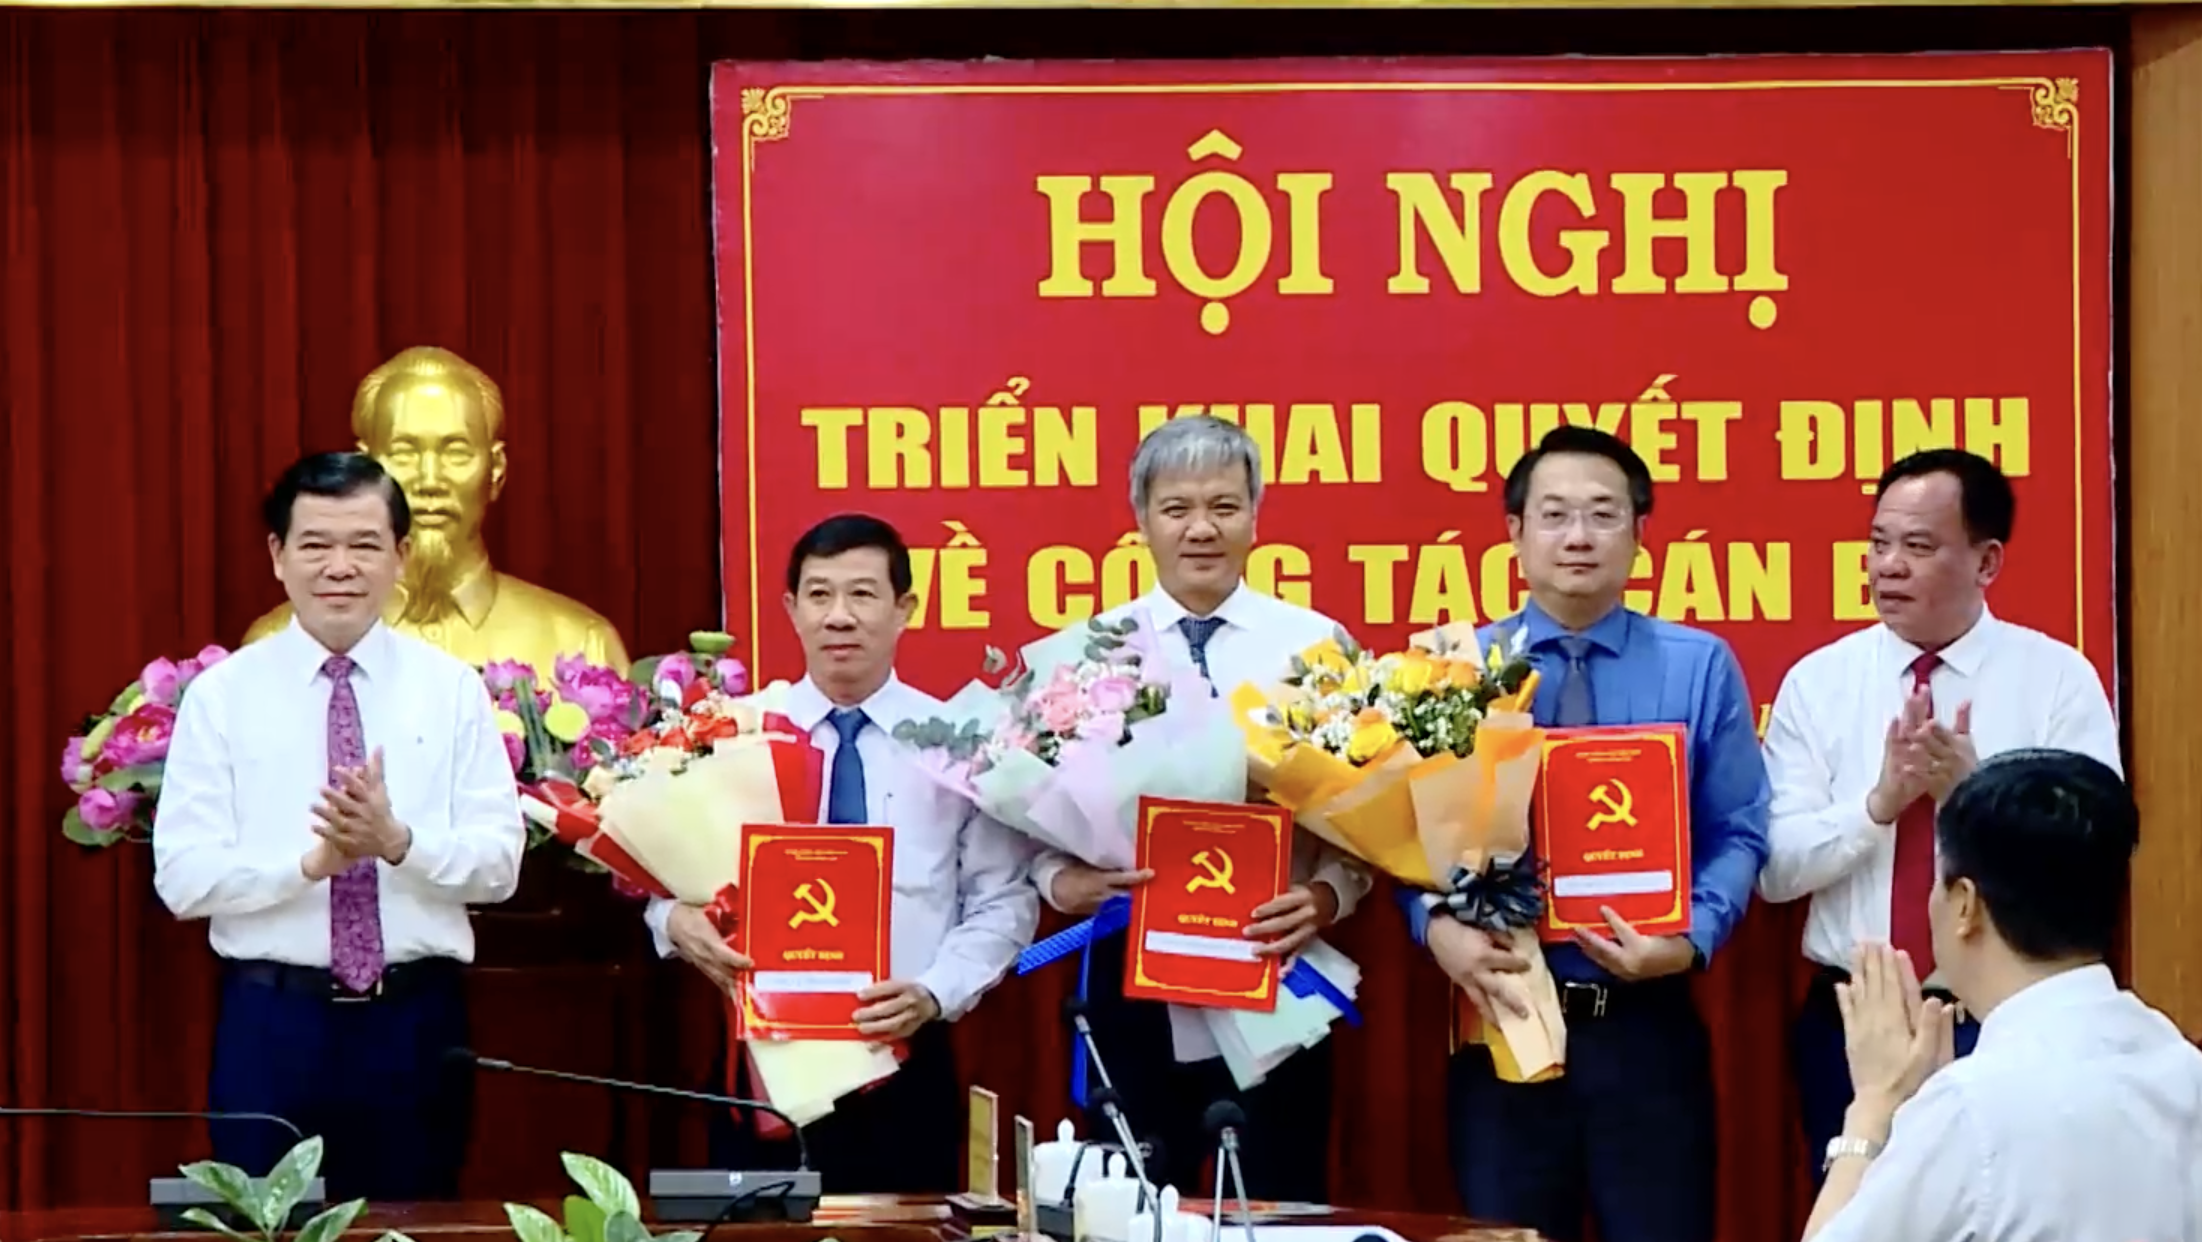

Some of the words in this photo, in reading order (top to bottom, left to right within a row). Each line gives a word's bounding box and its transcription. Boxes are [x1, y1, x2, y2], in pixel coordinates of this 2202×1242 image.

[1036, 129, 1334, 335] HỘI
[1386, 169, 1789, 329] NGHỊ
[801, 376, 1098, 488] TRIỂN
[1138, 403, 1382, 484] AI
[1774, 396, 2031, 495] ĐỊNH
[1026, 530, 1313, 631] CÔG
[1832, 540, 1881, 622] B
